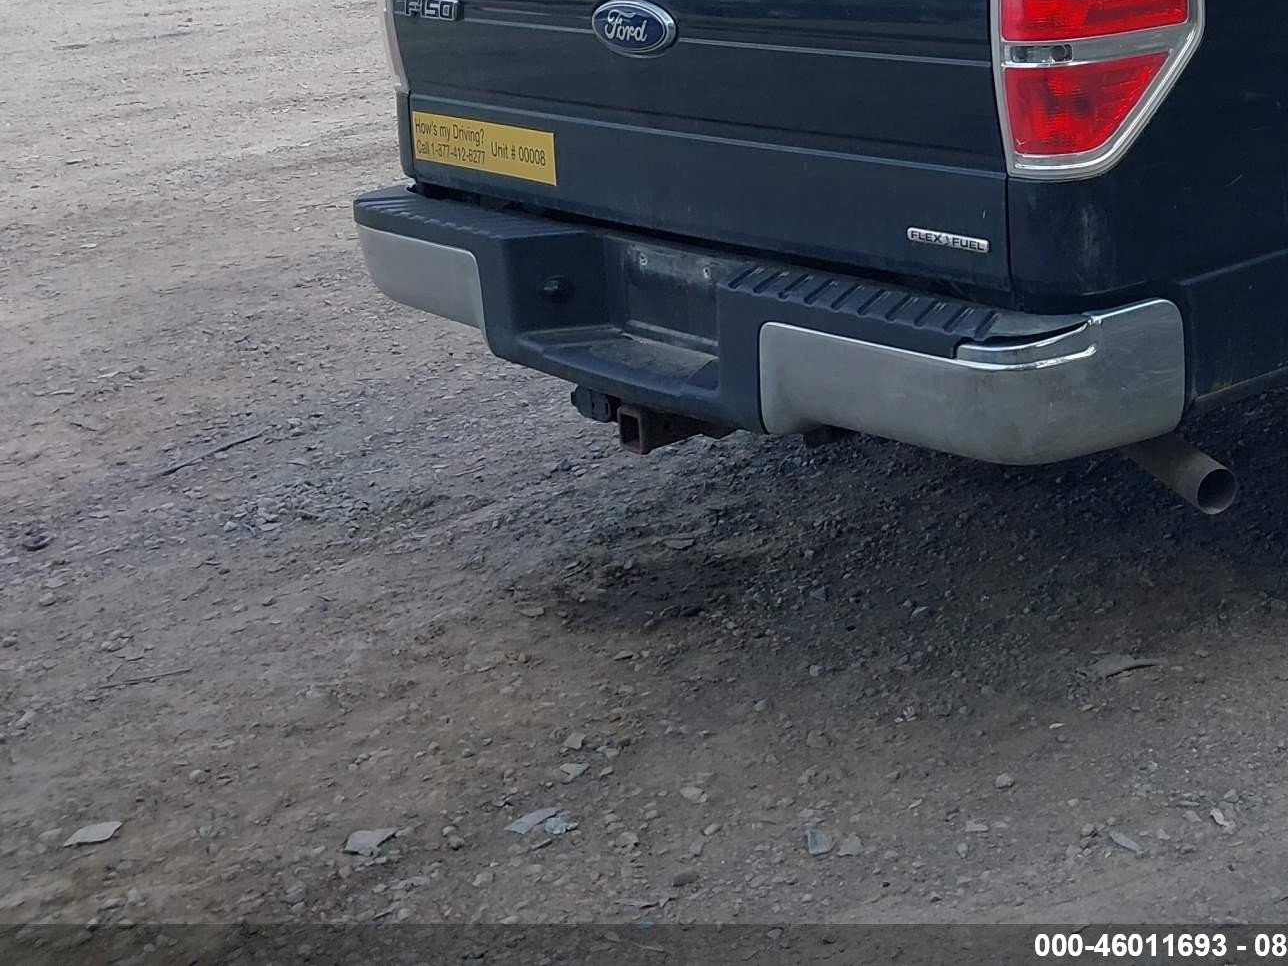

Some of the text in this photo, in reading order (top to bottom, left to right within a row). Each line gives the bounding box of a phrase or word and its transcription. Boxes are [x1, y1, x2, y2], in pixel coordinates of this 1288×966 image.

[604, 8, 648, 43] Ford
[415, 117, 485, 147] How's my Driving?
[416, 140, 430, 155] Call
[490, 141, 546, 167] Unit # 00008
[910, 230, 985, 251] FLEX FUEL
